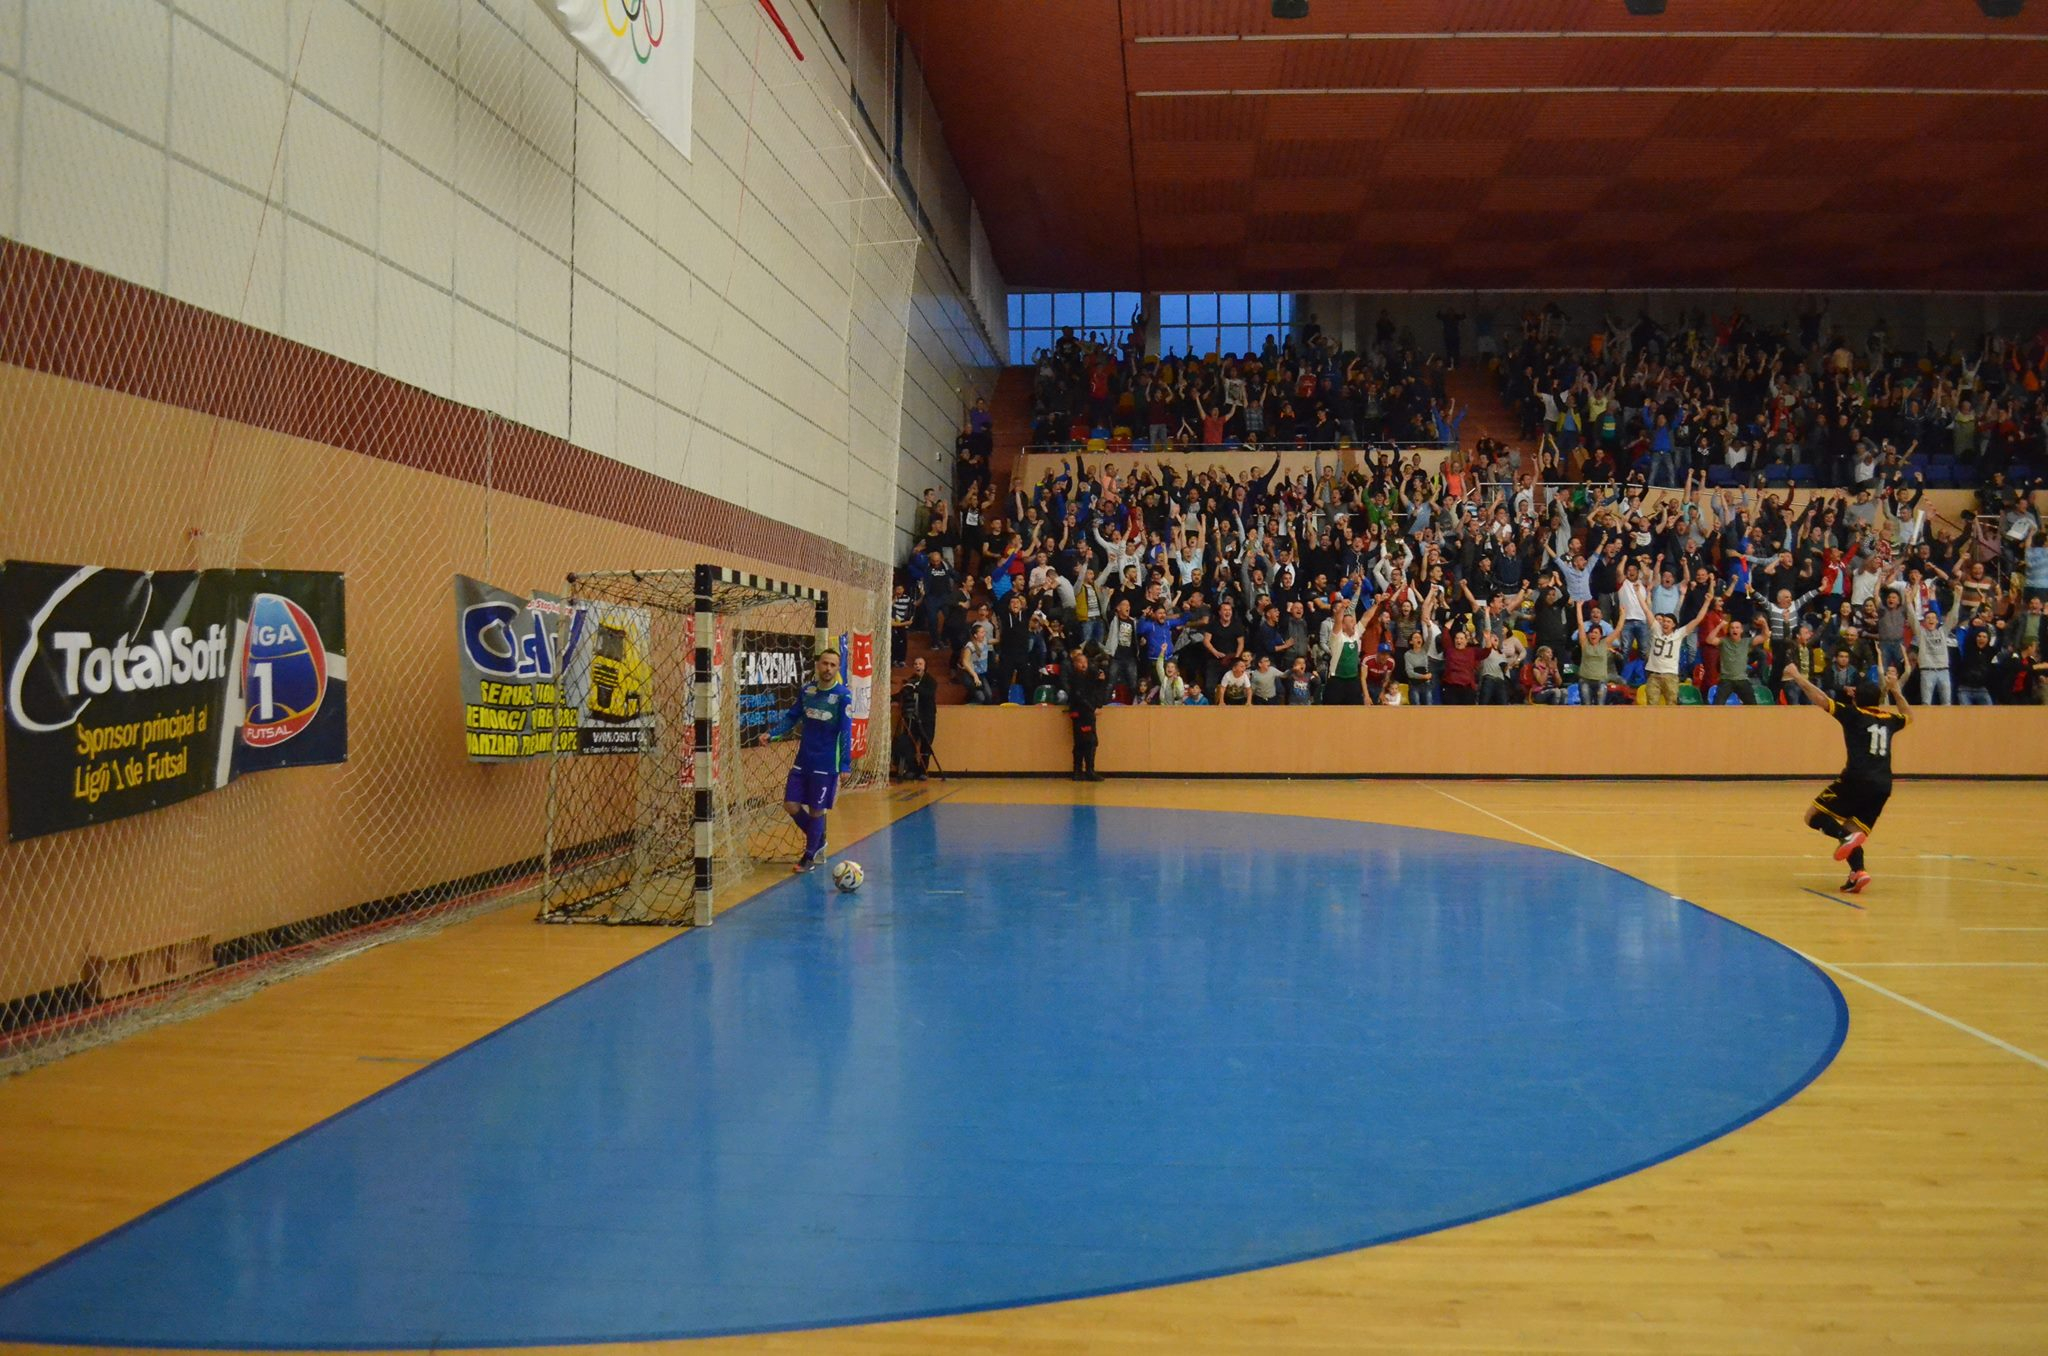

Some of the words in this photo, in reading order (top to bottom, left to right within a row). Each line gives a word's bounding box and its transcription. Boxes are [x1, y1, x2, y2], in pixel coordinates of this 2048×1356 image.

[53, 623, 227, 696] TotalSoft
[1652, 637, 1674, 659] 91
[253, 662, 274, 720] 1
[76, 721, 141, 760] Sponsor
[142, 705, 196, 751] principal
[246, 726, 293, 741] FUTSAL
[1866, 723, 1887, 757] 11
[125, 756, 143, 787] de
[147, 745, 188, 782] Futsal
